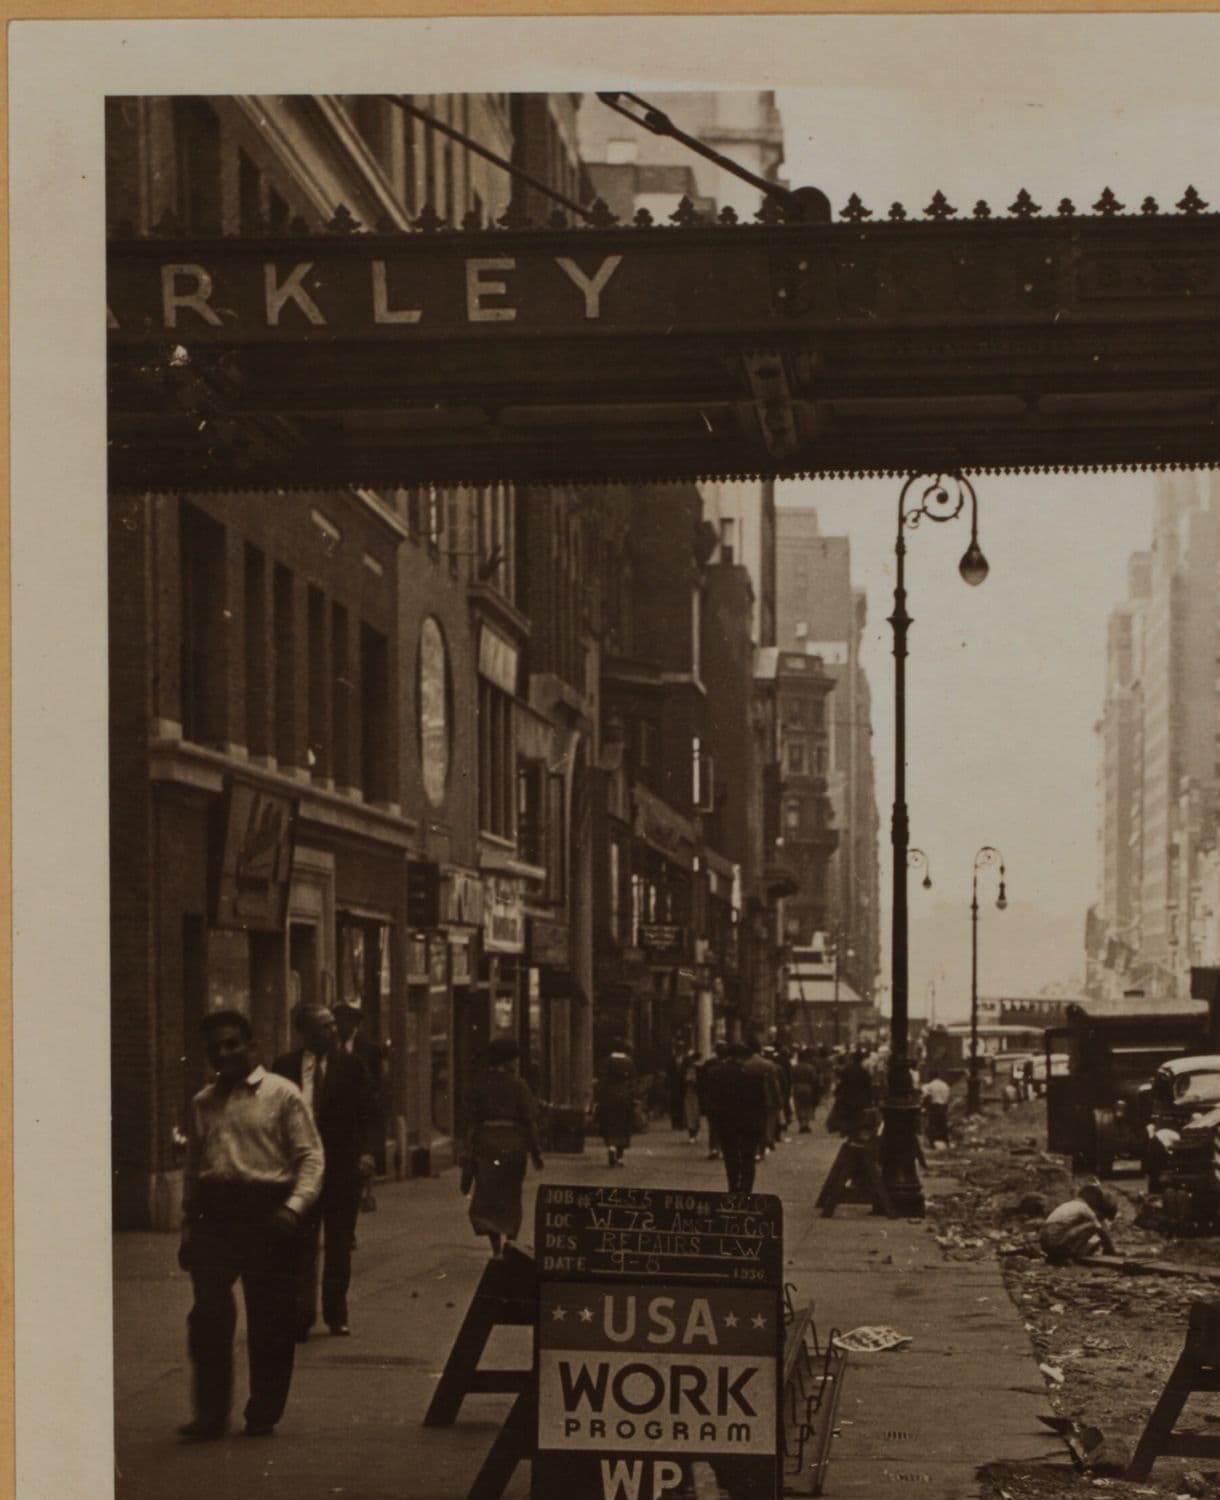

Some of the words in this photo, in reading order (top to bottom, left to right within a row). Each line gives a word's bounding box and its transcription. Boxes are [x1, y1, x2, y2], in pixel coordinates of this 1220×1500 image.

[107, 254, 624, 328] RKLEY
[545, 1212, 573, 1228] LOC
[590, 1207, 612, 1228] W
[624, 1211, 656, 1231] 72
[545, 1233, 577, 1250] DES
[602, 1231, 701, 1255] REPAIRS
[544, 1256, 587, 1271] DATE
[603, 1295, 718, 1345] USA
[559, 1362, 759, 1417] WORK
[565, 1418, 751, 1442] PROGRAM
